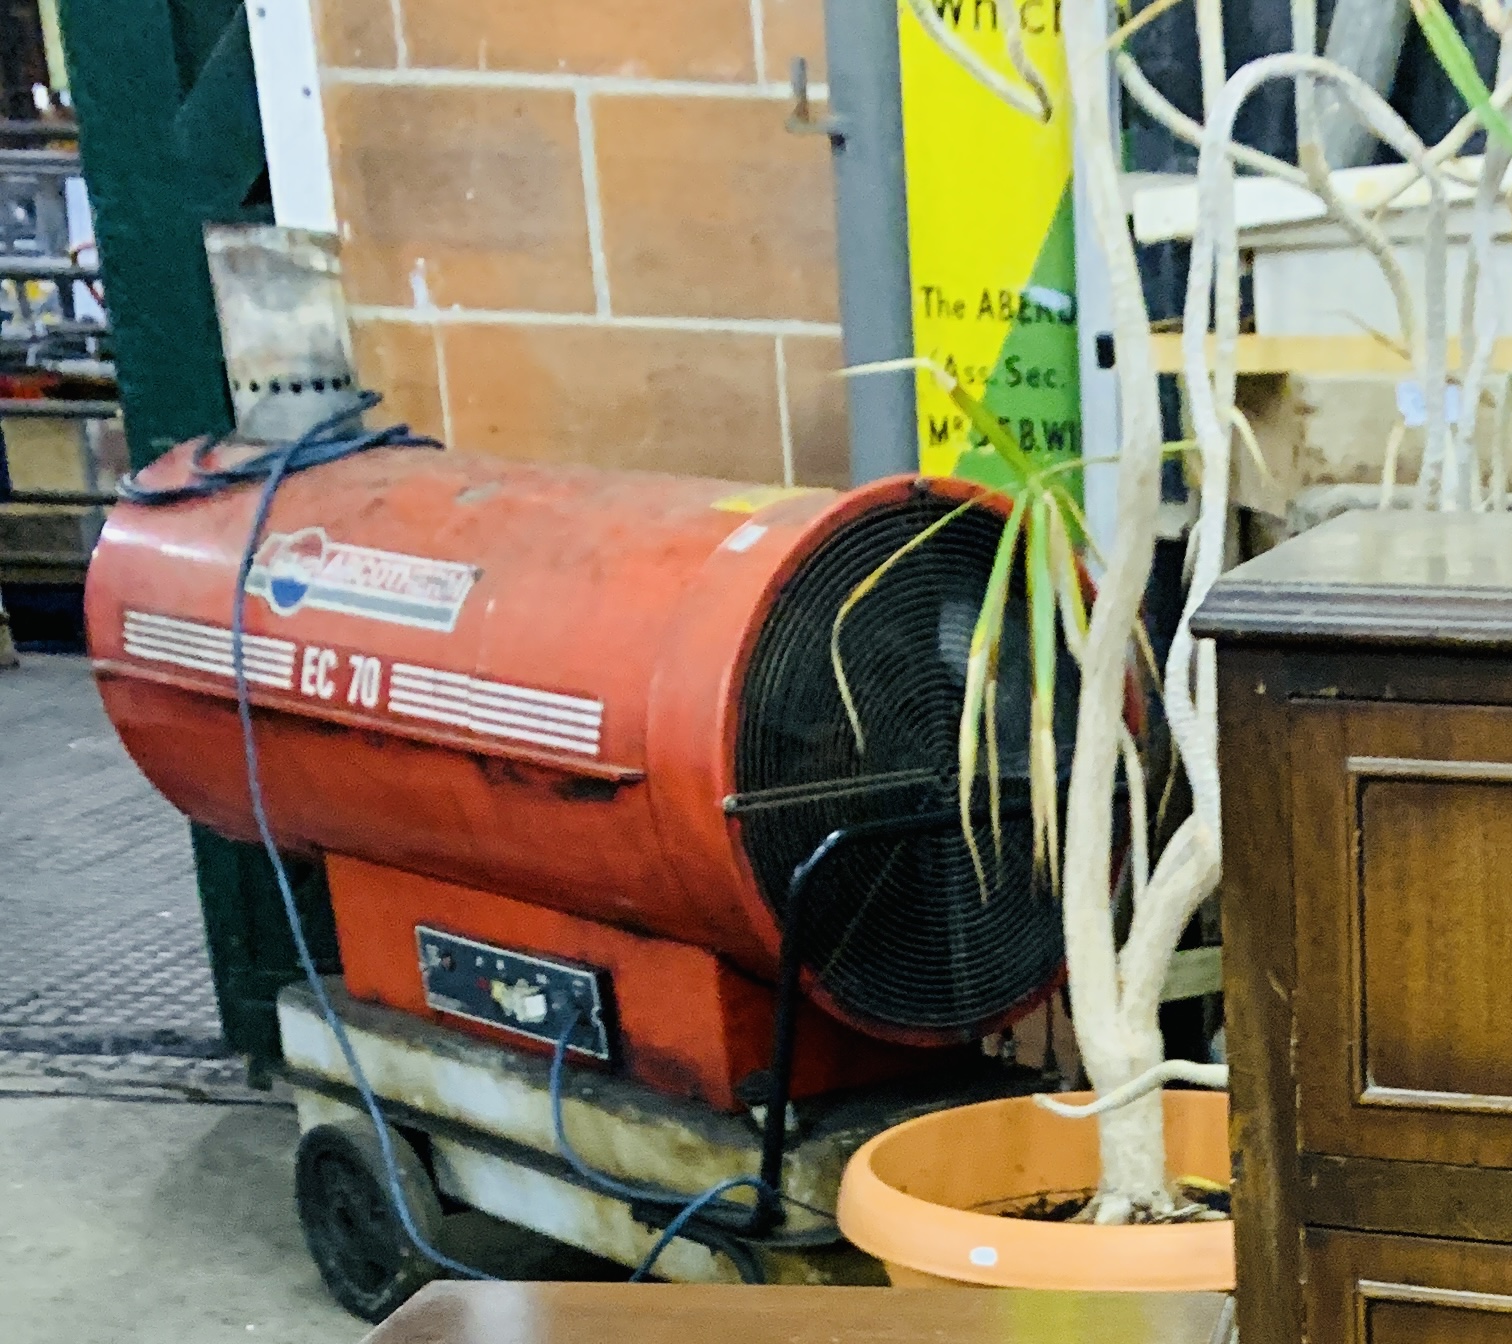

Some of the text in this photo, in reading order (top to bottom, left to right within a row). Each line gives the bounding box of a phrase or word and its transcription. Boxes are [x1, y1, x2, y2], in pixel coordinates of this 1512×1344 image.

[921, 286, 966, 320] The
[1004, 354, 1066, 389] Sec.
[301, 645, 382, 709] EC 70
